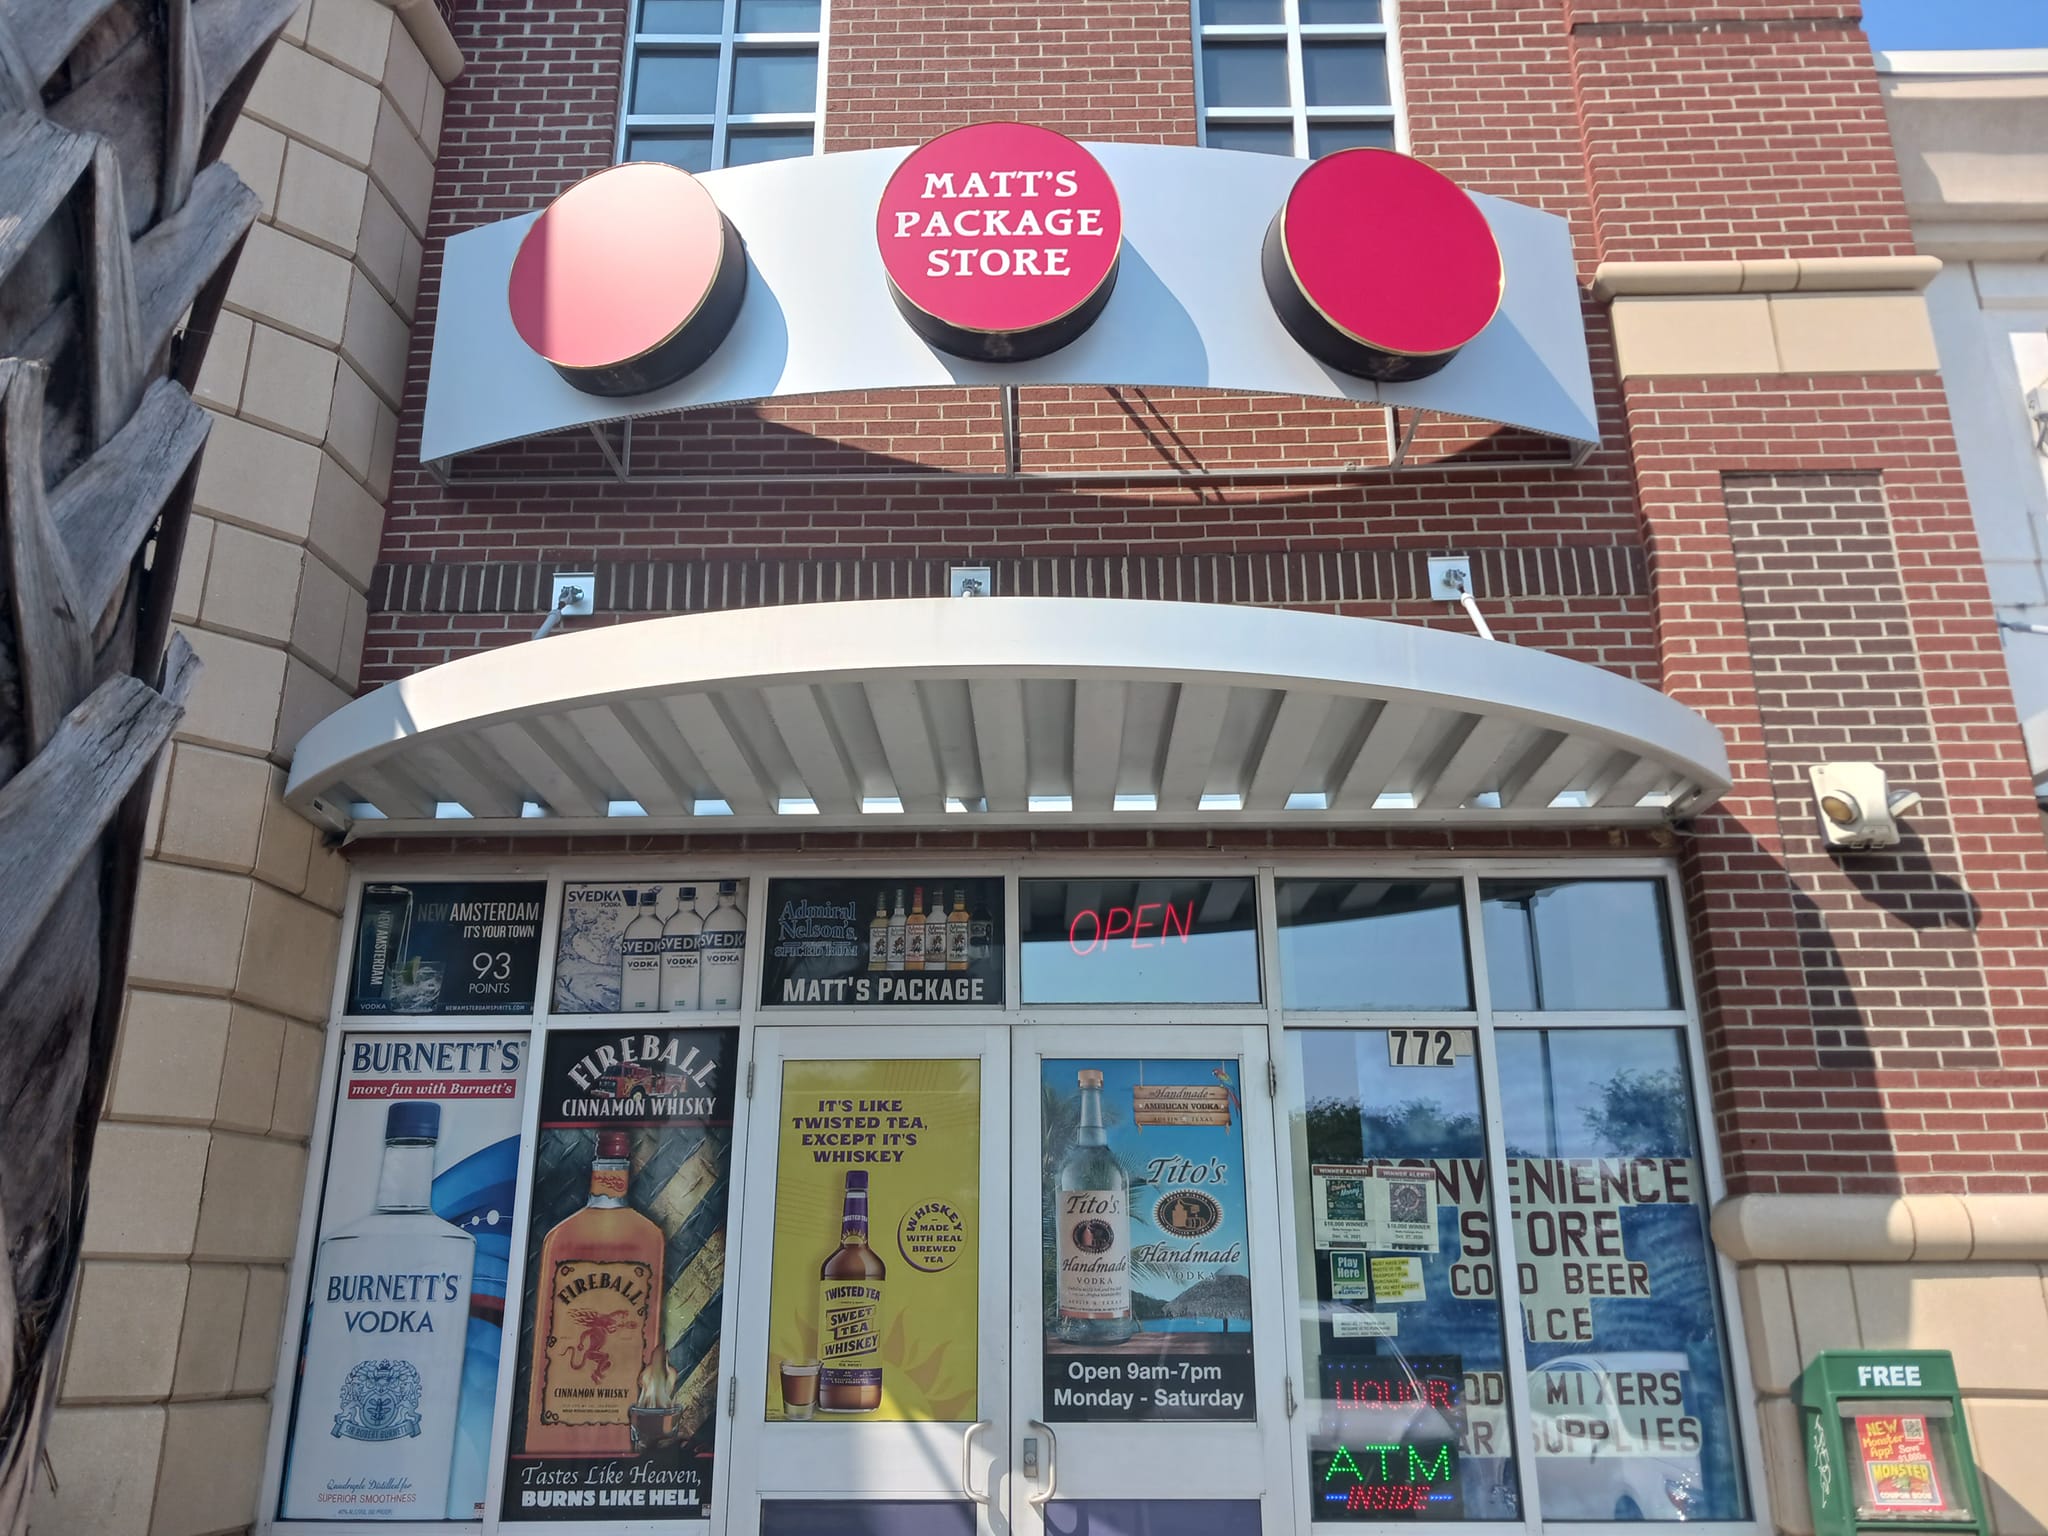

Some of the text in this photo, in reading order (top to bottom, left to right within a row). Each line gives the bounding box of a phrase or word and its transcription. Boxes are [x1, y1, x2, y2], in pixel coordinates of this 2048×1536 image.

[920, 169, 1079, 199] MATT'S
[893, 208, 1104, 238] PACKAGE
[926, 248, 1071, 277] STORE
[568, 890, 622, 903] SVEDKA
[417, 902, 540, 922] NEW AMSTERDAM
[778, 899, 857, 921] Admiral
[463, 925, 535, 939] IT'S YOUR TOWN
[778, 917, 858, 940] Nelson's
[1069, 899, 1195, 956] OPEN
[370, 929, 389, 986] AMSTERDAM
[472, 952, 511, 980] 93
[627, 960, 659, 968] VODKA
[666, 957, 699, 965] VODKA
[706, 954, 740, 962] VODKA
[468, 982, 510, 994] POINTS
[783, 976, 984, 1002] MATT'S PACKAGE
[351, 1039, 521, 1074] BURNETT'S
[1391, 1030, 1454, 1066] 772
[567, 1034, 718, 1091] FIREBALL
[351, 1082, 513, 1097] more fun with Burnett's
[1154, 1087, 1209, 1099] Handmade
[562, 1096, 717, 1117] CINNAMON WHISKY
[818, 1099, 903, 1113] IT'S LIKE
[1144, 1102, 1220, 1111] AMERICAN VODKA
[792, 1116, 928, 1131] TWISTED TEA,
[801, 1133, 918, 1146] EXCEPT IT'S
[813, 1150, 904, 1163] WHISKEY
[1146, 1154, 1228, 1185] Tito's
[1368, 1158, 1690, 1205] NVENIENCE
[1066, 1192, 1120, 1215] Tito's
[906, 1202, 963, 1232] WHISKEY
[920, 1224, 950, 1232] MADE
[1460, 1210, 1622, 1257] SORE
[912, 1245, 956, 1253] BREWED
[1139, 1241, 1241, 1264] Handmade
[1062, 1255, 1127, 1274] Handmade
[1337, 1257, 1359, 1269] Play
[1337, 1267, 1361, 1279] Here
[1076, 1277, 1113, 1285] VODKA
[1165, 1271, 1217, 1280] VODKA
[1450, 1262, 1650, 1296] COD BEER
[327, 1272, 459, 1302] BURNETT'S
[556, 1272, 641, 1306] FIREBALL
[824, 1285, 881, 1302] TWISTED TEA
[344, 1310, 434, 1333] VODKA
[830, 1307, 873, 1326] SWEET
[1526, 1308, 1593, 1341] ICE
[840, 1321, 869, 1336] TEA
[824, 1334, 879, 1356] WHISKEY
[1068, 1361, 1222, 1383] Open 9am-7pm
[1857, 1365, 1922, 1387] FREE
[554, 1388, 629, 1399] CINNAMON WHISKY
[1054, 1389, 1134, 1410] Monday
[1154, 1389, 1244, 1410] Saturday
[1335, 1380, 1451, 1410] LIQUOR
[1865, 1418, 1898, 1437] NEW
[1862, 1434, 1904, 1448] Monster
[1325, 1444, 1450, 1481] ATM
[1870, 1446, 1894, 1460] App!
[520, 1460, 701, 1486] Tastes Like Heaven,
[326, 1478, 366, 1493] Quadruple
[368, 1478, 400, 1490] Distilled
[318, 1493, 417, 1503] SUPERIOR SMOOTHNESS
[521, 1488, 700, 1507] BURNS LIKE HELL
[1346, 1485, 1431, 1510] INSIDE
